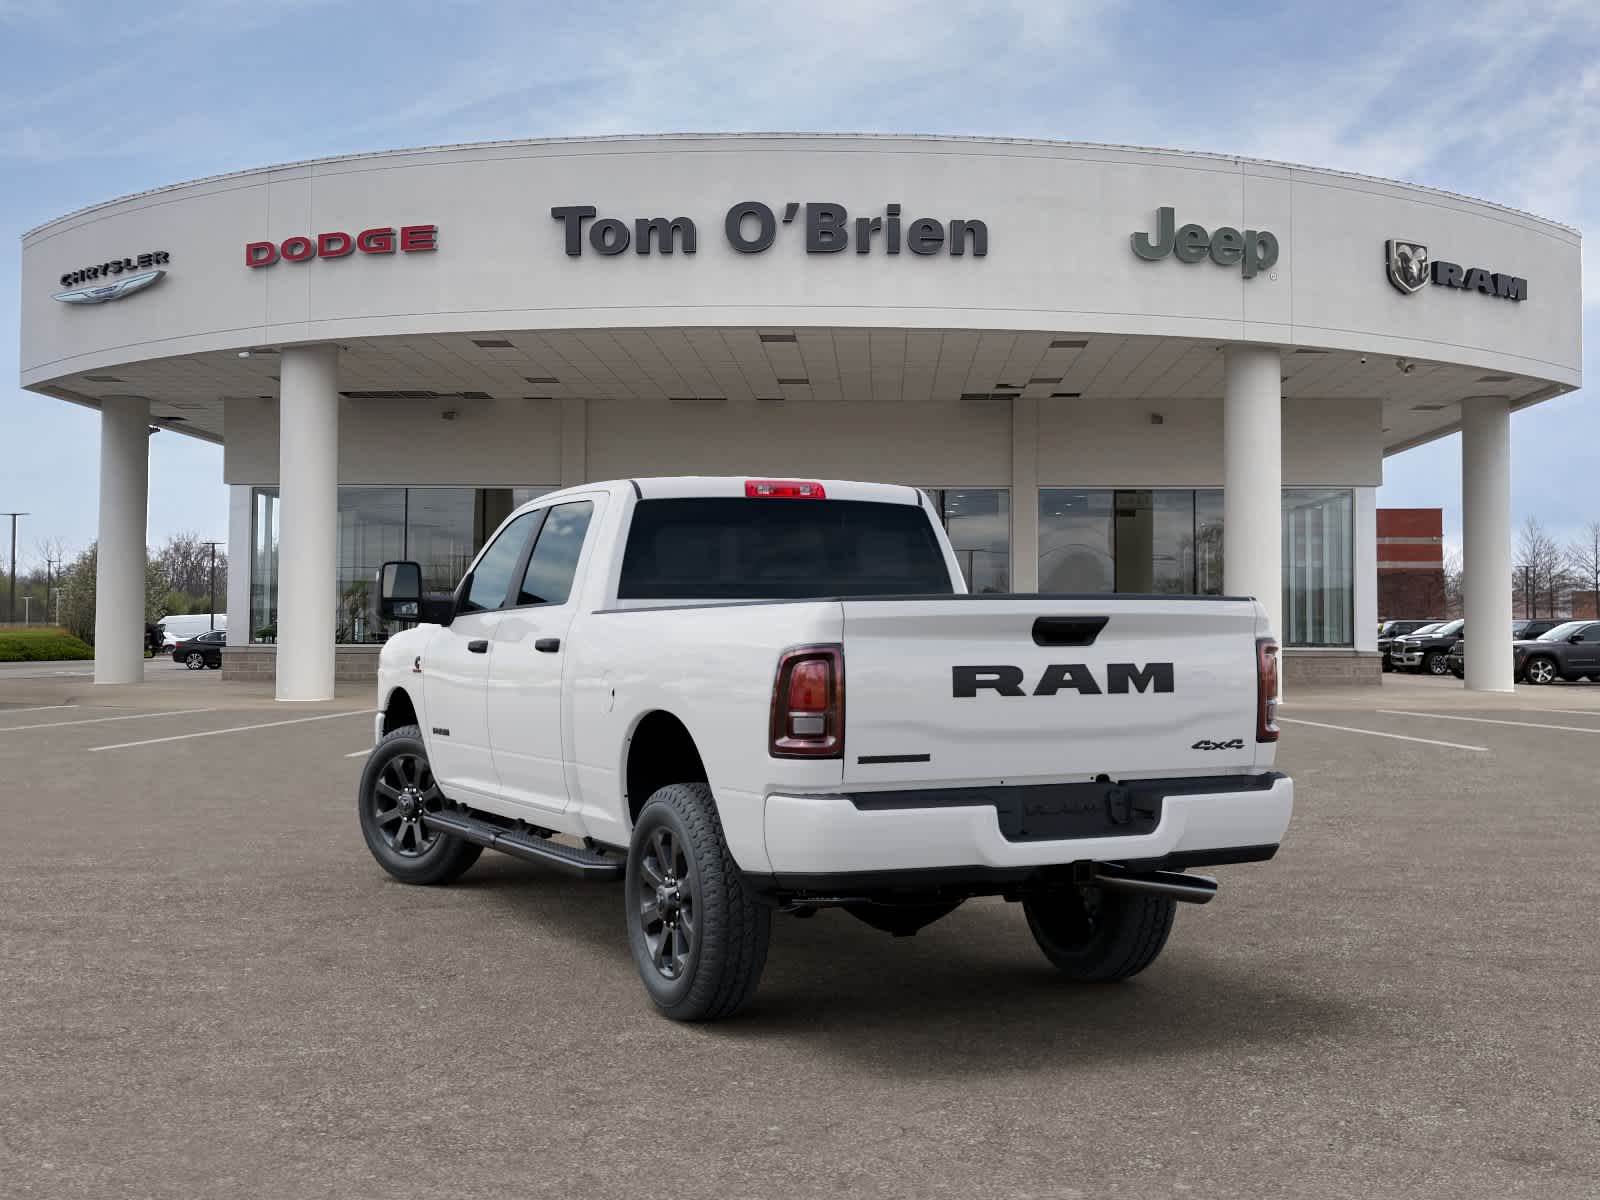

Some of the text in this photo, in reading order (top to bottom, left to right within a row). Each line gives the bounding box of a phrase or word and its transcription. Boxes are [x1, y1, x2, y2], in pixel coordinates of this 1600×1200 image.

[246, 225, 438, 268] DODGE
[551, 200, 988, 257] Tom O'Brien
[1130, 206, 1279, 280] Jeep
[60, 250, 170, 287] CHRYSLER
[1431, 260, 1528, 302] RAM
[952, 662, 1175, 698] RAM
